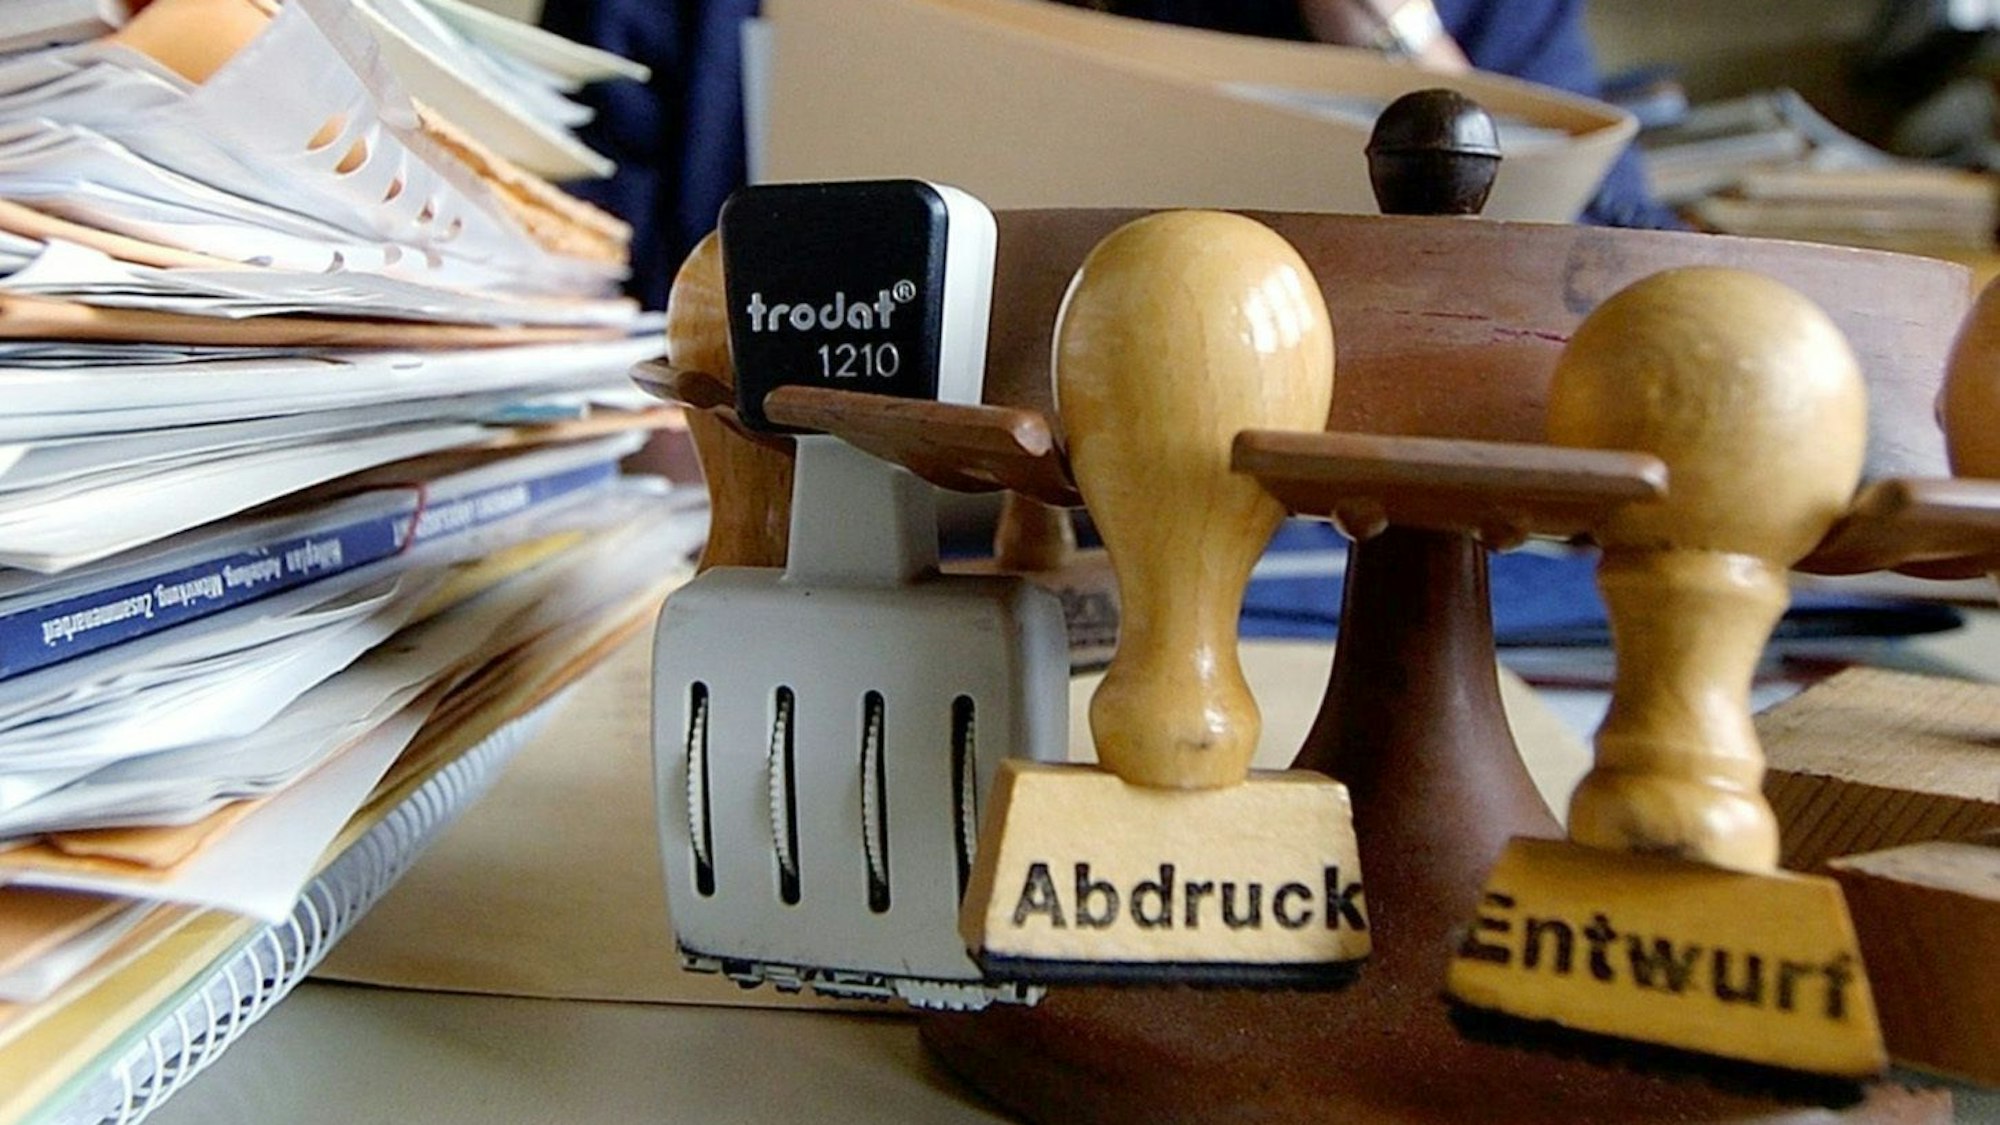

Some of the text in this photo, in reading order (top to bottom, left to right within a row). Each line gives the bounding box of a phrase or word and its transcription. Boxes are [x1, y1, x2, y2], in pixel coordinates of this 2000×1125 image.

[818, 342, 900, 378] 1210
[1011, 861, 1368, 931] Abdruck
[1458, 890, 1855, 1021] Entwurf
